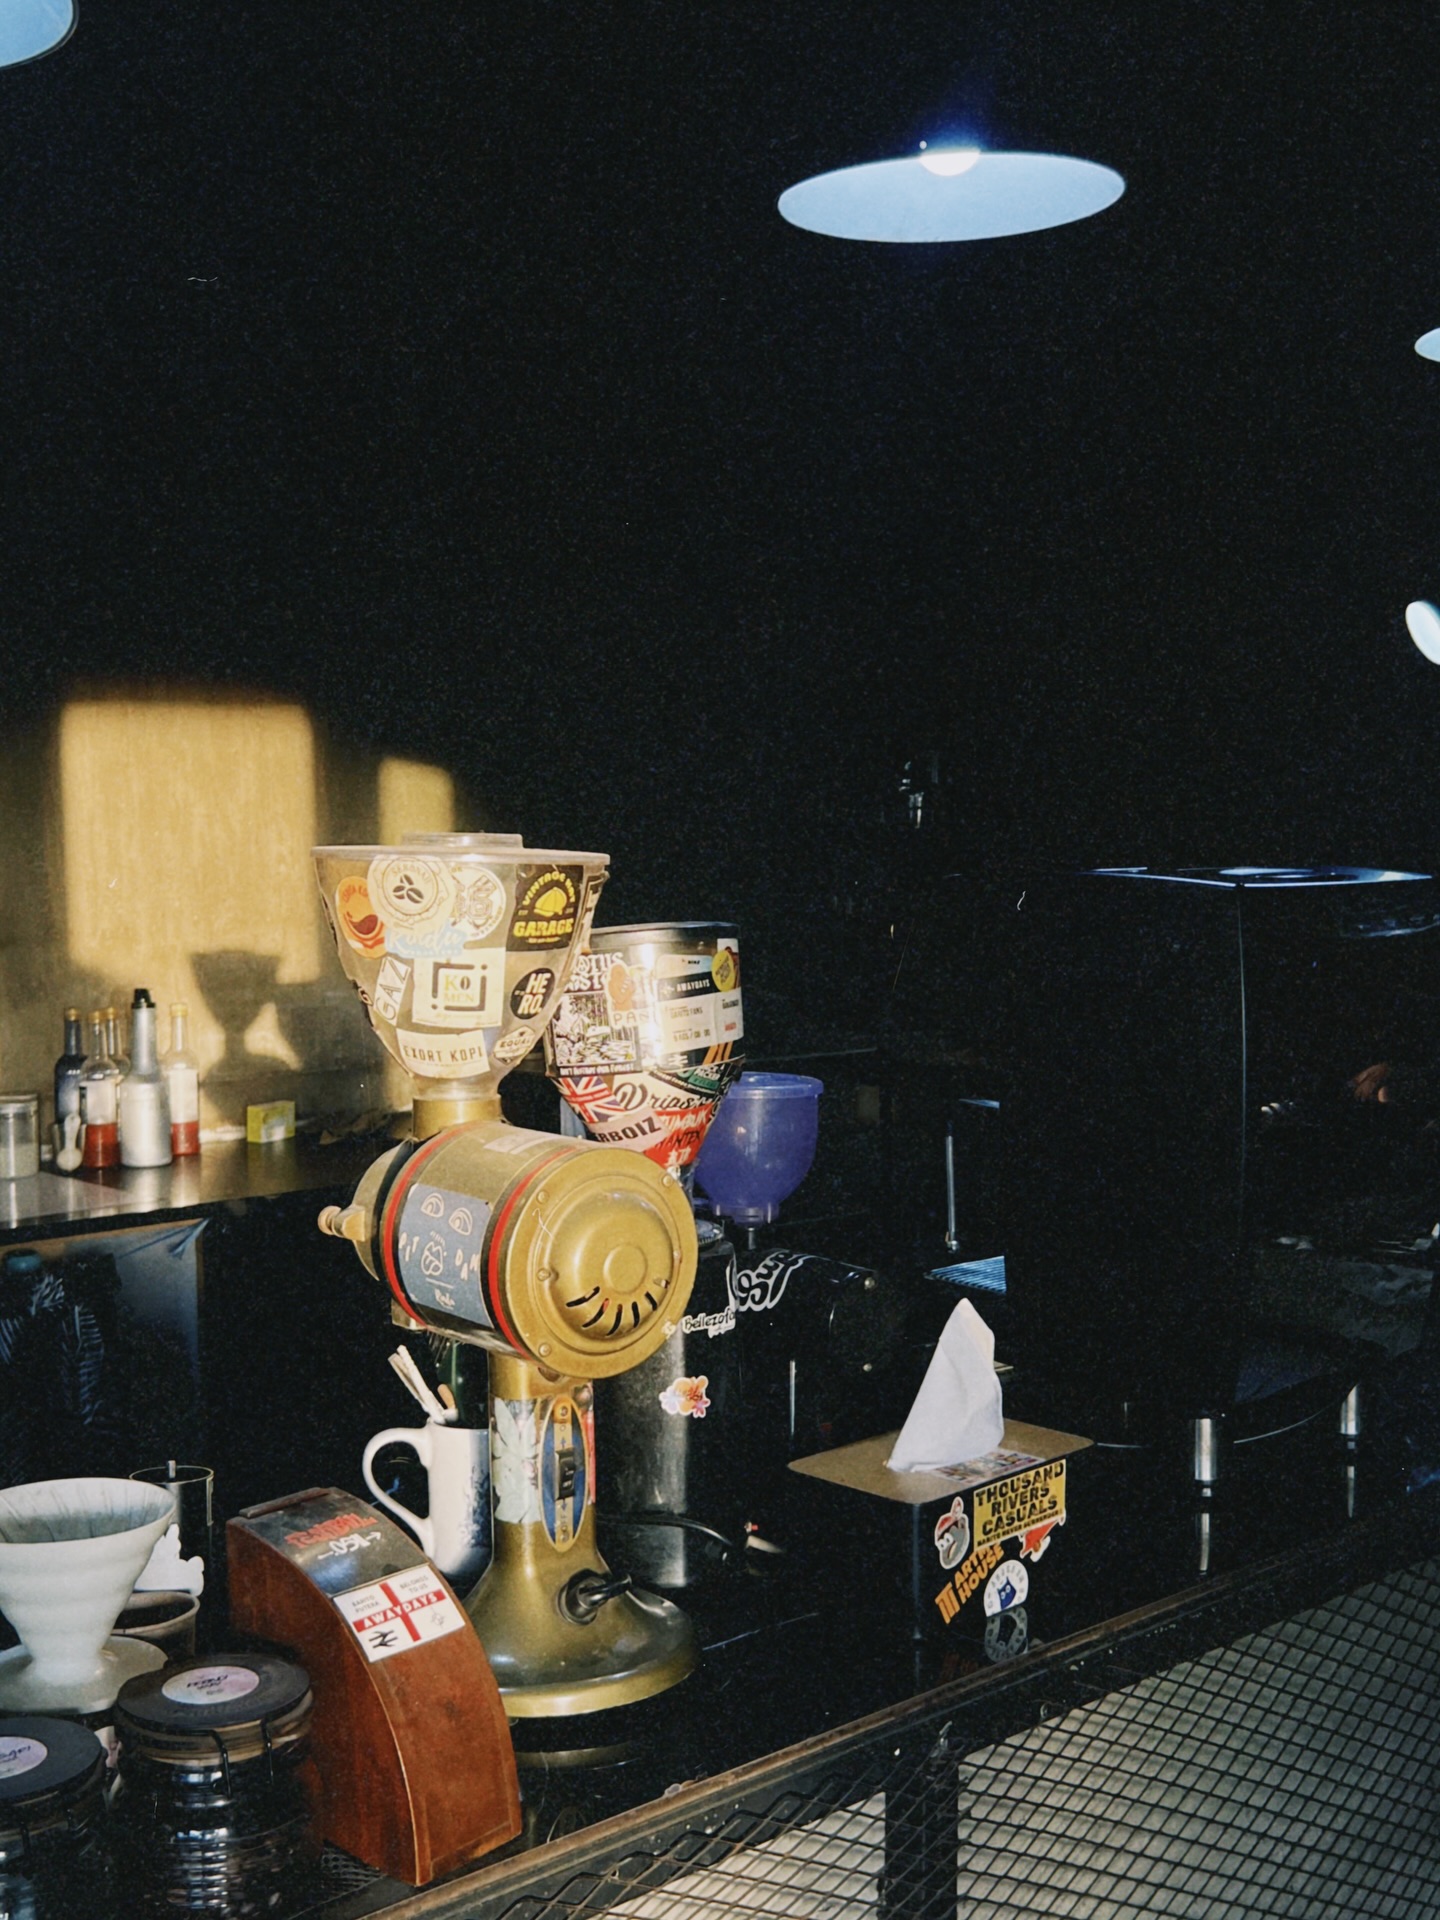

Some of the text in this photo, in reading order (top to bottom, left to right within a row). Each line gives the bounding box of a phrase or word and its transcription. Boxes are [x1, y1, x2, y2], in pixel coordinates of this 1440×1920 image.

[513, 918, 574, 937] GARAGE
[529, 973, 551, 994] HE
[450, 1045, 484, 1062] KOPI
[975, 1461, 1064, 1507] THOUSAND
[991, 1482, 1050, 1518] RIVERS
[981, 1495, 1058, 1537] CASUALS
[957, 1542, 1004, 1604] HOUSE
[363, 1592, 438, 1629] AWAYDAYS
